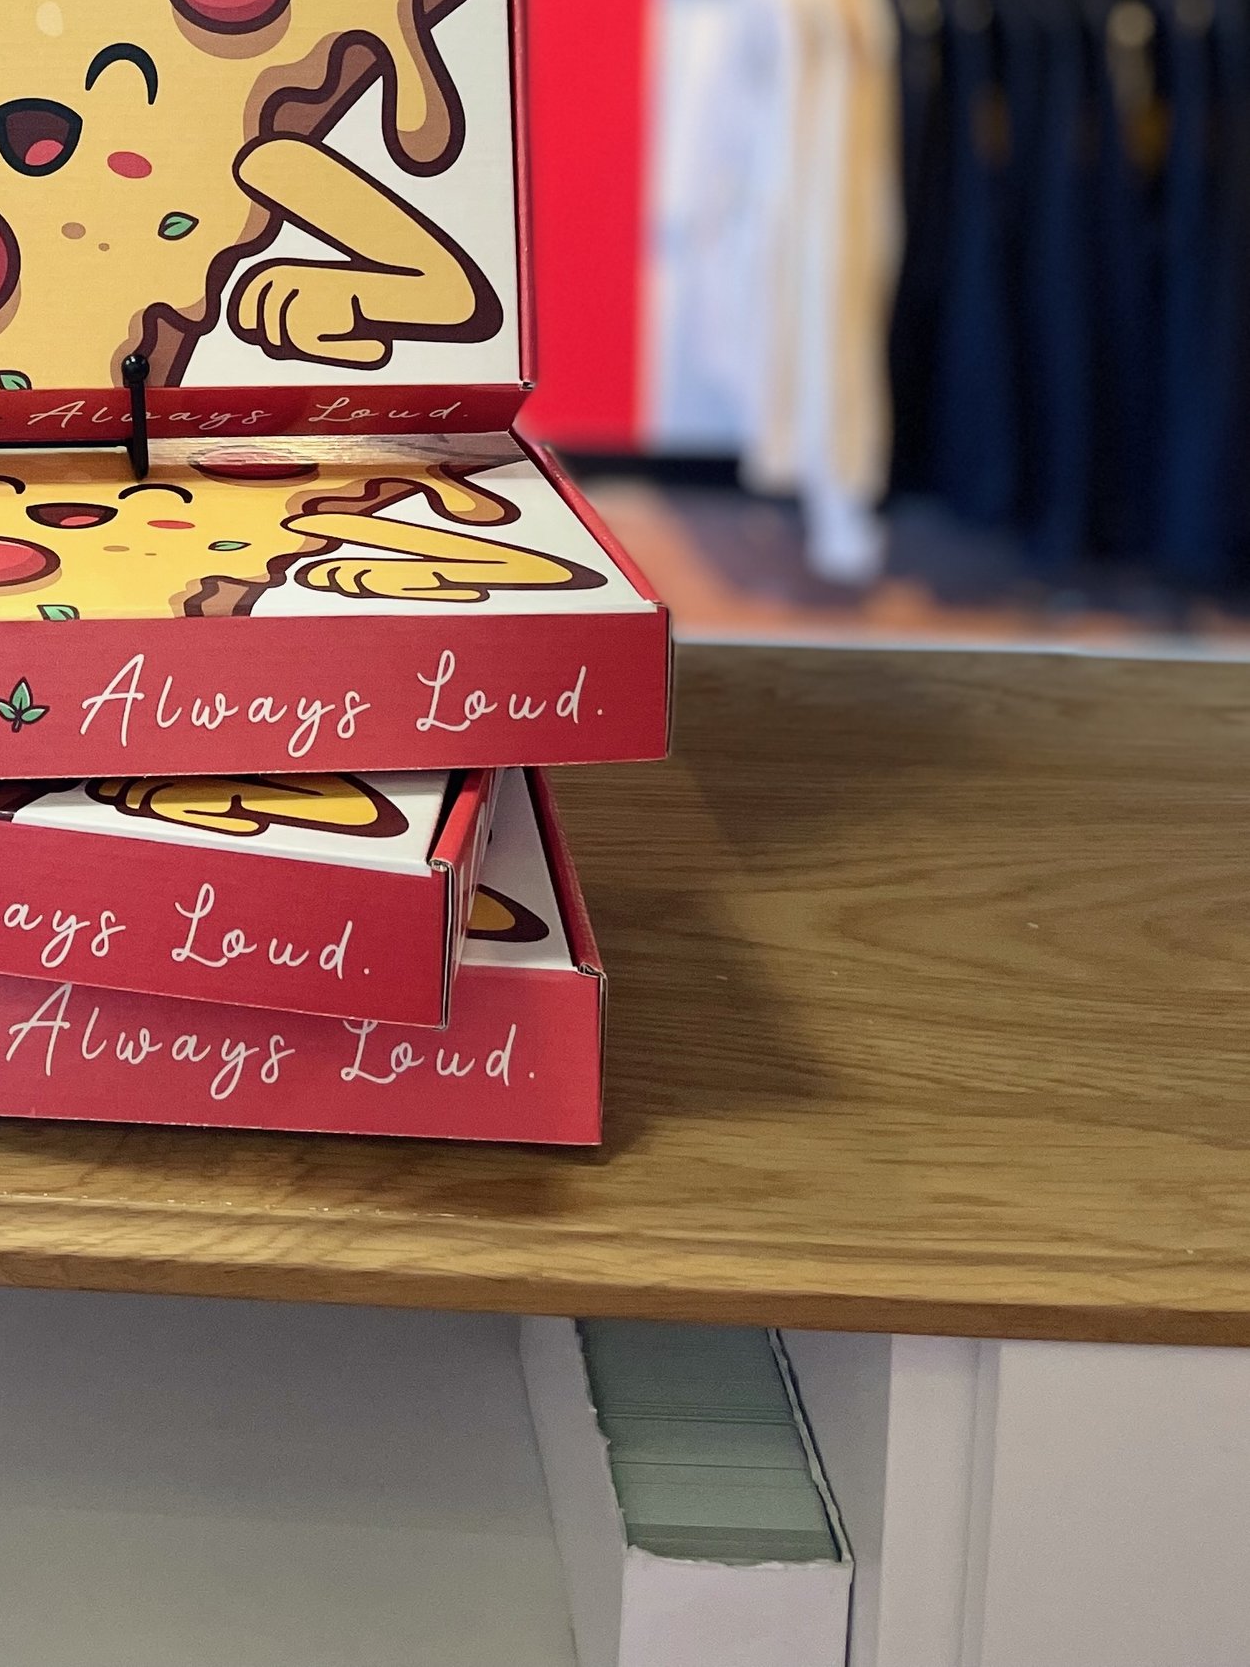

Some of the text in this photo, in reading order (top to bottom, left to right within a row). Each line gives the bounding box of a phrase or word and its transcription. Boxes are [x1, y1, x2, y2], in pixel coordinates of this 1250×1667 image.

[308, 396, 469, 423] Loud.
[80, 652, 372, 759] Always
[415, 649, 605, 733] Loud.
[171, 882, 372, 981] Loud.
[5, 982, 296, 1101] Always
